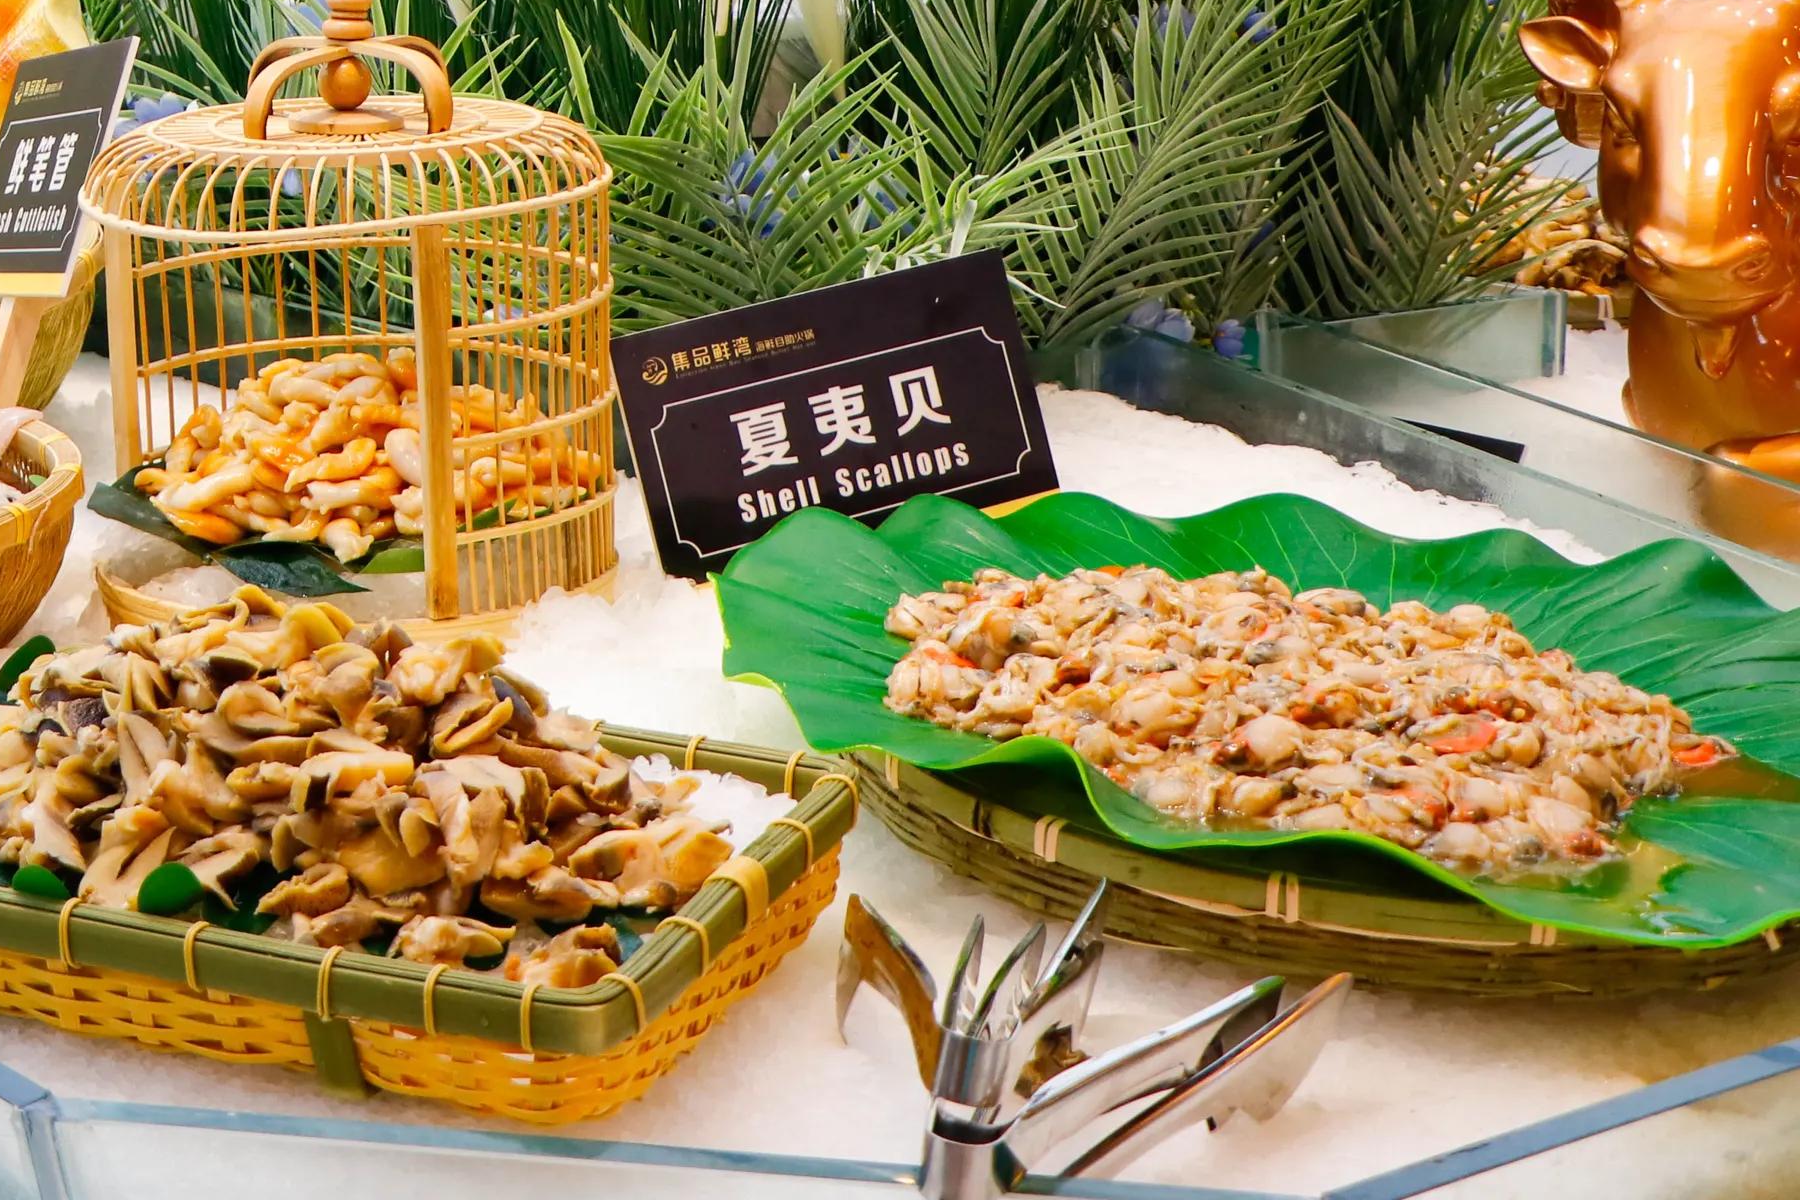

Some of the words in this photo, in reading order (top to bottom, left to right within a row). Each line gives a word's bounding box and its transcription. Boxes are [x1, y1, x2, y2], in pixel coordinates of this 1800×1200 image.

[4, 131, 80, 195] 鲜笔管
[13, 203, 68, 234] Cuttlefish
[671, 336, 752, 372] 集品鲜湾
[729, 365, 952, 478] 夏夷贝
[737, 476, 821, 523] Shell
[835, 442, 970, 498] Scallops
